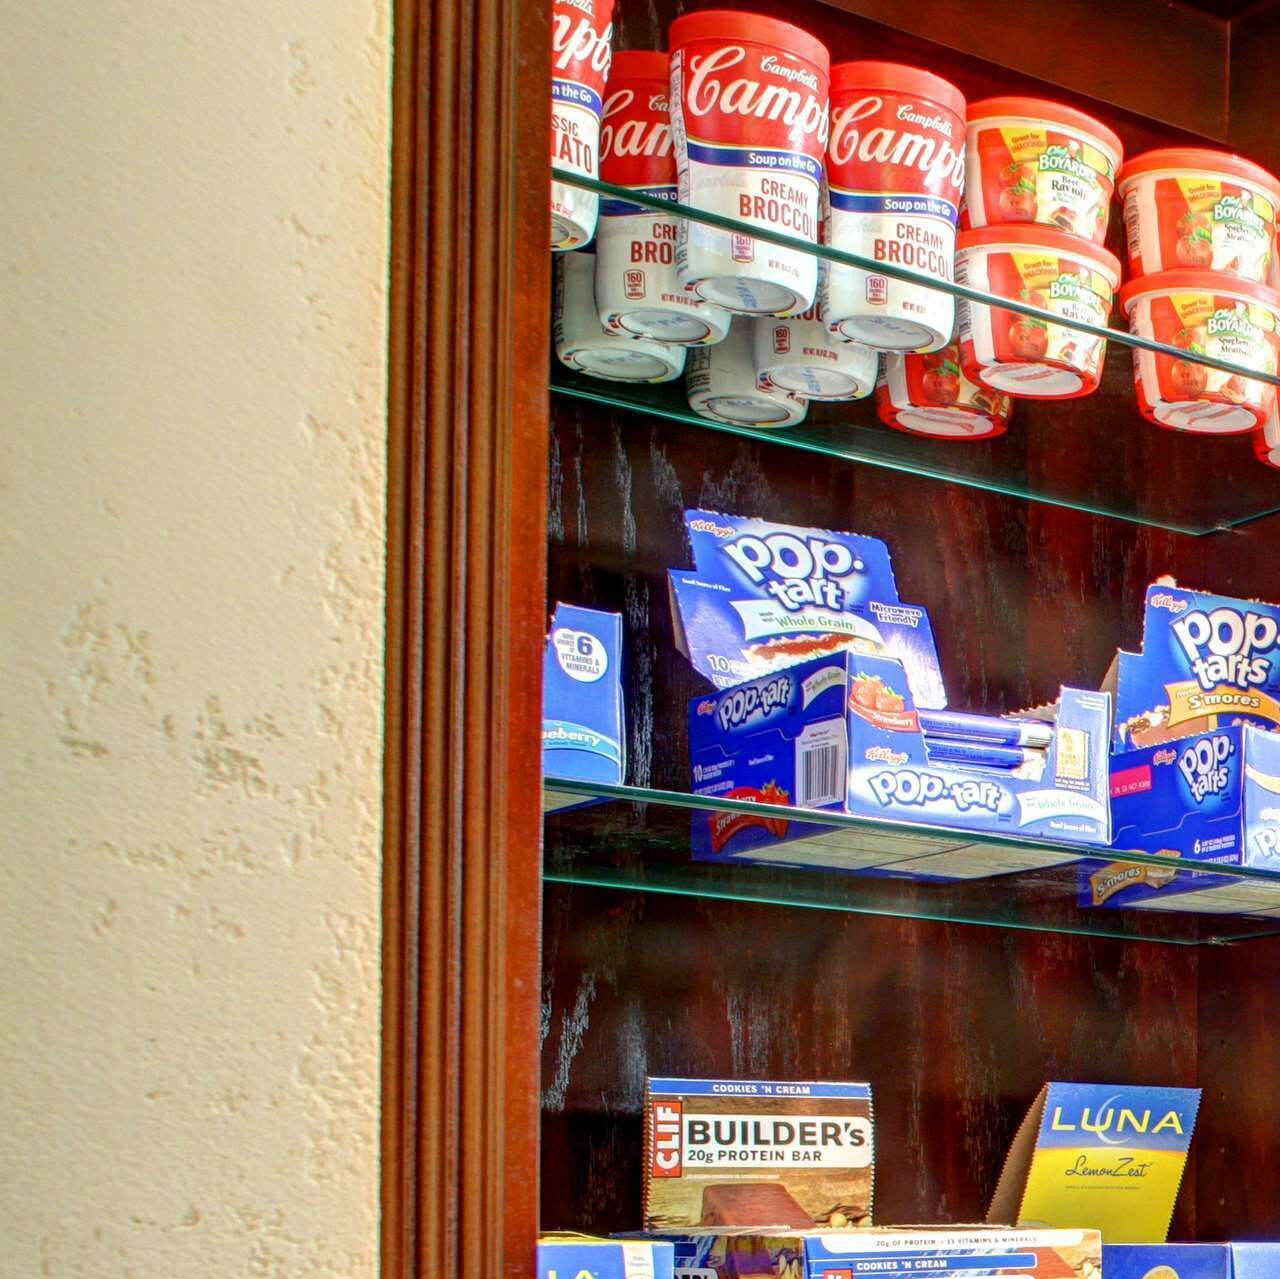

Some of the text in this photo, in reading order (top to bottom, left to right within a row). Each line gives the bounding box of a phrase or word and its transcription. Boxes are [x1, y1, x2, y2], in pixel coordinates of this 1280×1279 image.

[562, 84, 592, 104] the Go
[749, 152, 817, 174] Soup on the Go
[760, 177, 810, 208] CREAMY
[884, 198, 951, 218] Soup on the Go
[895, 222, 945, 249] CREAMY
[690, 519, 737, 538] Kellogg's
[870, 601, 923, 618] Microwave
[1151, 593, 1188, 613] Kellogg's
[776, 615, 854, 632] Whole Grain
[877, 612, 919, 627] Friendly
[576, 635, 594, 657] 6
[561, 652, 600, 667] VITAMINS &
[565, 661, 601, 676] MINERALS
[708, 655, 730, 672] 10
[1188, 692, 1261, 710] S'mores
[865, 746, 909, 764] Kellogg's
[1193, 838, 1201, 855] 6
[712, 1084, 811, 1095] COOKIES 'N CREAM
[1051, 1106, 1185, 1135] LUNA
[656, 1105, 680, 1171] CLIF
[687, 1149, 823, 1164] 20g PROTEIN BAR
[903, 1238, 937, 1247] PROTEIN
[856, 1259, 948, 1272] COOKIES 'N CREAM
